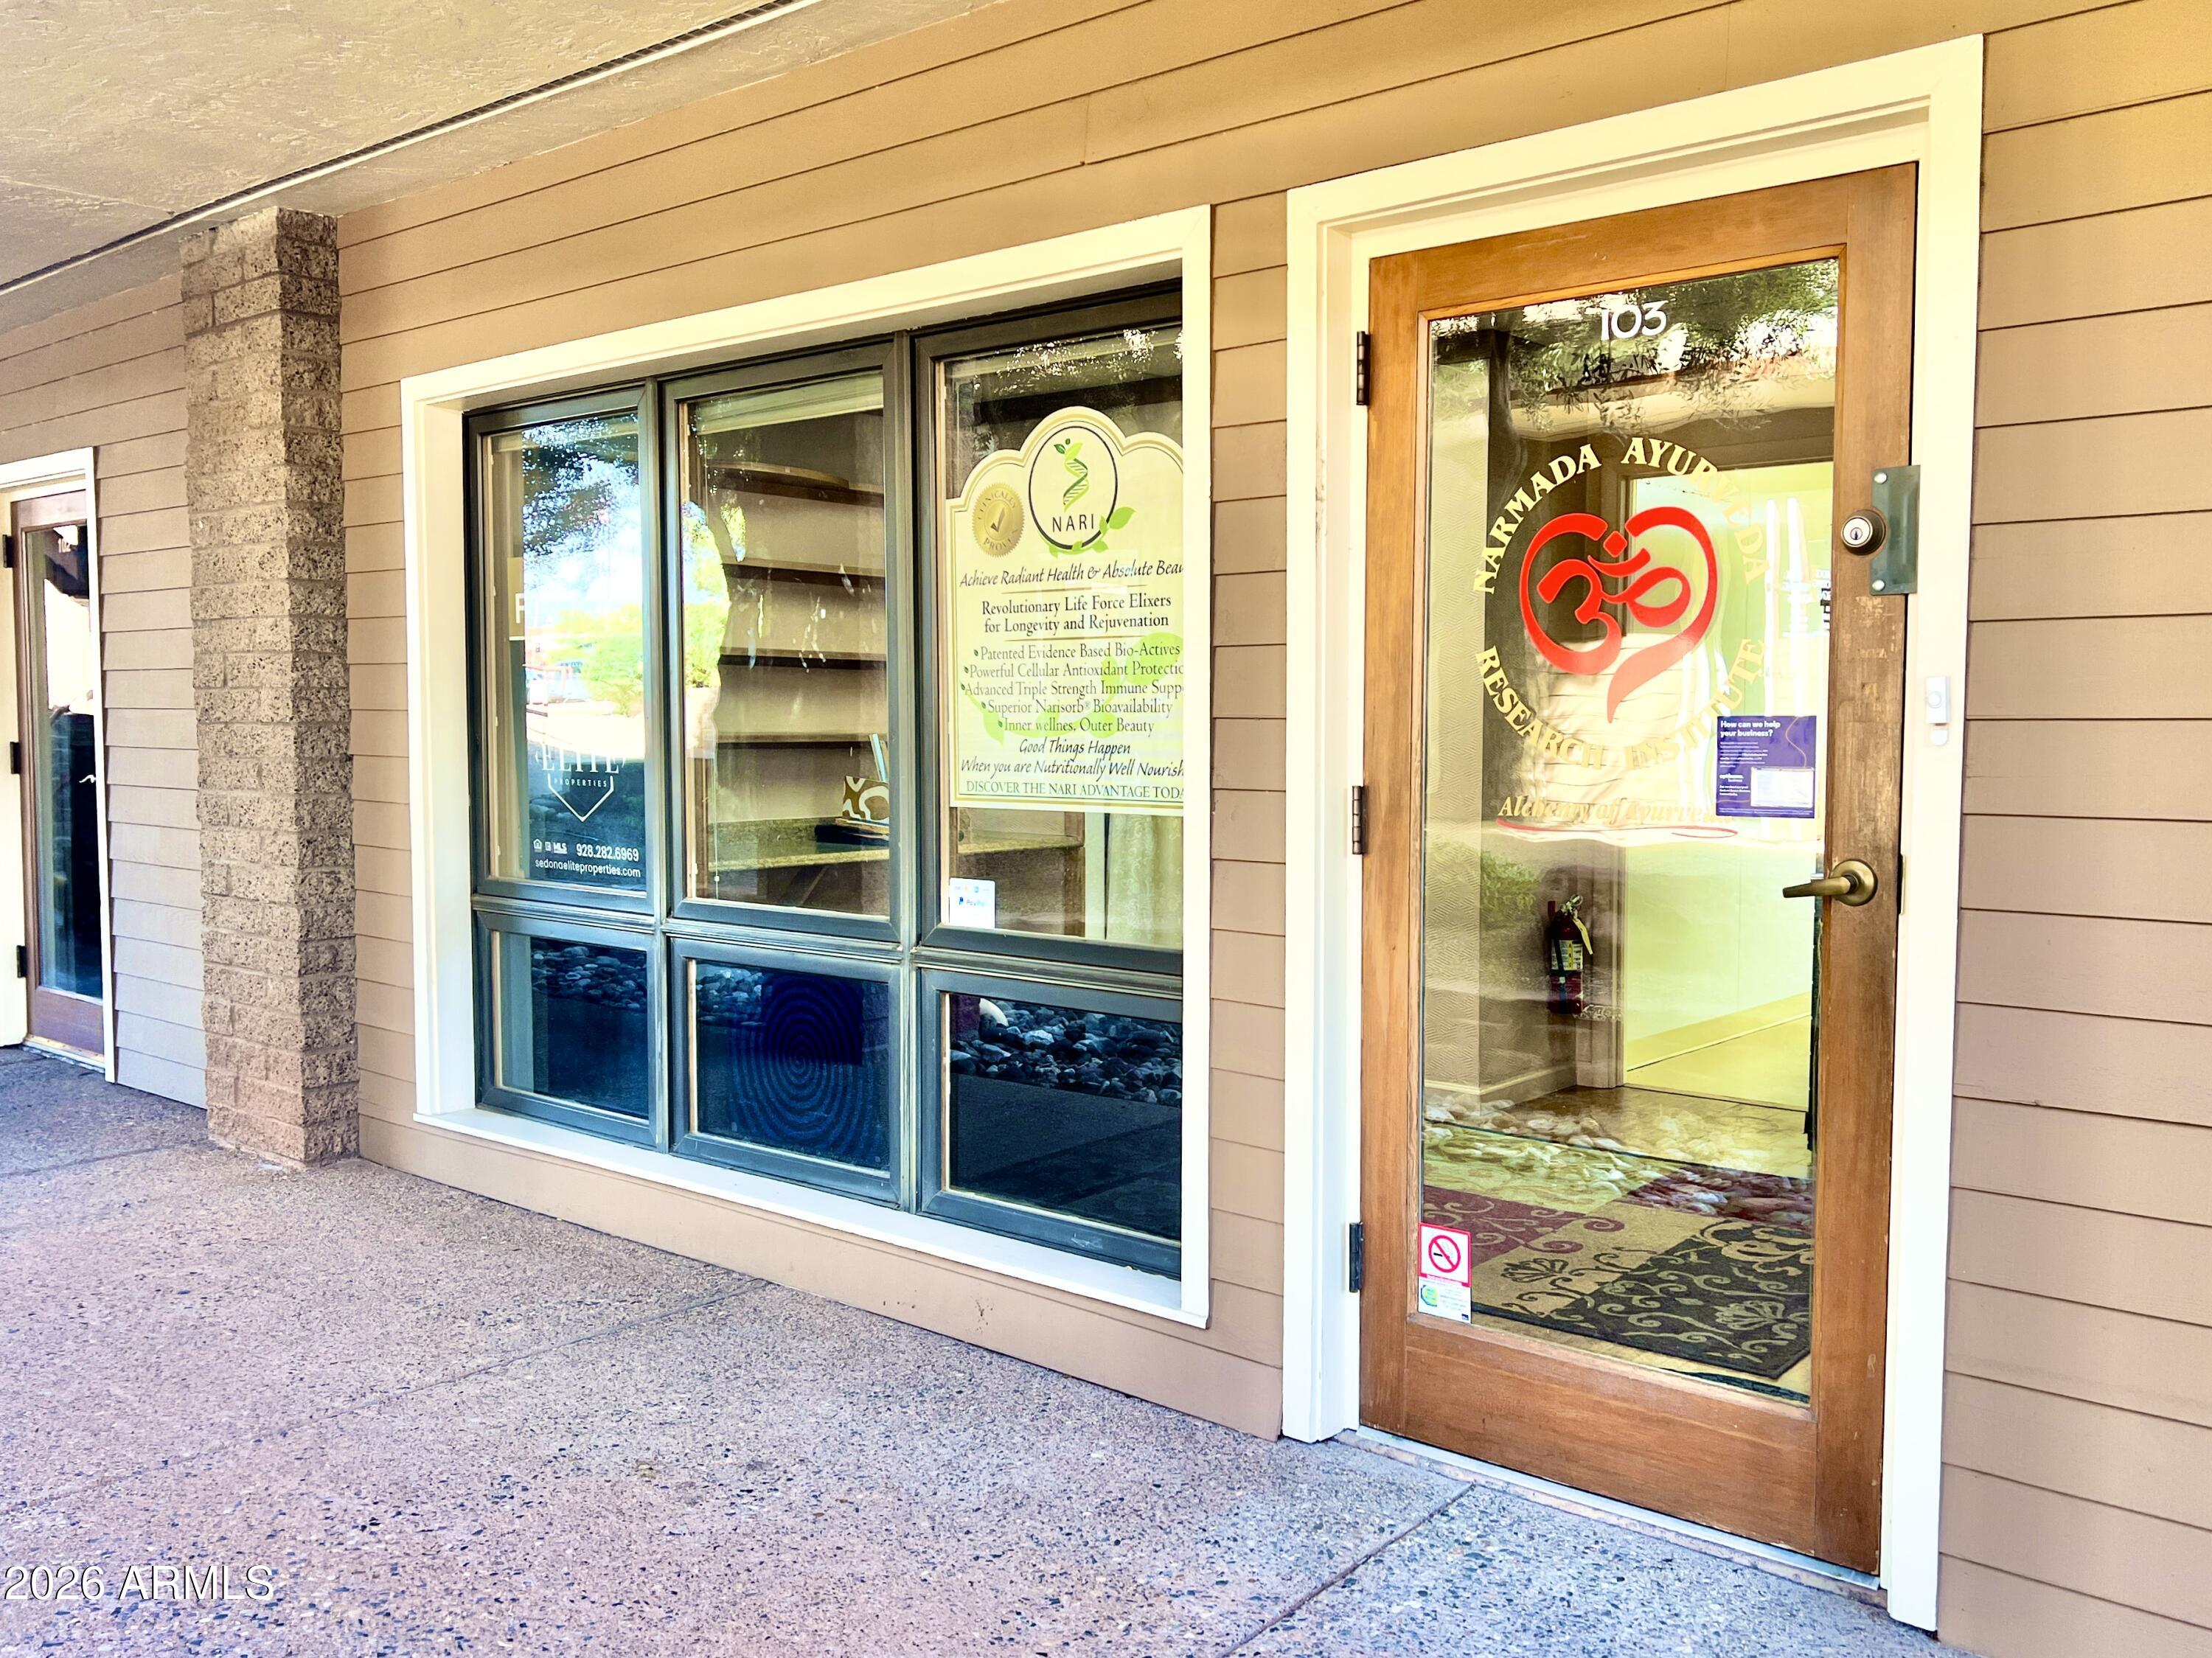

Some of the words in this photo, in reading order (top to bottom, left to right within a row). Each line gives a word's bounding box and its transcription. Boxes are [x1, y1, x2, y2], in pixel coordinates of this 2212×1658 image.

[1601, 300, 1669, 341] 103
[1052, 513, 1094, 532] NARI
[1473, 443, 1602, 595] NARMADA
[1621, 437, 1770, 585] AYURVEDA
[959, 569, 998, 588] Achieve
[1001, 566, 1045, 585] Radiant
[1047, 562, 1084, 582] Health
[1088, 565, 1101, 579] &
[1102, 559, 1153, 579] Absolute
[982, 599, 1060, 617] Revolutionary
[1065, 595, 1088, 611] Life
[1092, 595, 1125, 610] Force
[1130, 593, 1172, 608] Elixers
[985, 618, 1001, 633] for
[1005, 616, 1060, 636] Longevity
[1063, 614, 1085, 630] and
[1090, 612, 1169, 633] Rejuvenation
[981, 645, 1024, 660] Patented
[1029, 644, 1076, 658] Evidence
[1080, 642, 1110, 658] Based
[1115, 641, 1180, 657] Bio-Actives
[970, 663, 1014, 678] Powerful
[1018, 662, 1060, 678] Cellular
[1063, 661, 1128, 676] Antioxidant
[965, 681, 1014, 695] Advanced
[1015, 680, 1048, 700] Triple
[1051, 680, 1096, 700] Strength
[1101, 680, 1148, 694] Immune
[1152, 679, 1183, 699] Supp
[988, 699, 1032, 718] Superior
[1093, 698, 1173, 718] Bioavailability
[1475, 645, 1606, 770] RESEARCH
[1624, 638, 1765, 771] INSTITUTE
[1004, 717, 1032, 731] Inner
[1079, 717, 1113, 732] Outer
[1116, 717, 1155, 737] Beauty
[1720, 730, 1736, 738] your
[1737, 729, 1773, 737] business?
[1764, 720, 1781, 729] help
[1019, 736, 1048, 754] Good
[1049, 736, 1085, 762] Things
[1088, 740, 1130, 761] Happen
[961, 756, 990, 772] When
[990, 762, 1011, 779] you
[1014, 762, 1032, 773] are
[1034, 758, 1106, 782] Nutritionally
[1109, 759, 1135, 775] Well
[554, 778, 608, 787] PROPERTIES
[966, 780, 1022, 793] DISCOVER
[1020, 782, 1046, 794] THE
[1048, 783, 1077, 795] NARI
[1080, 784, 1150, 798] ADVANTAGE
[1625, 799, 1733, 825] Ayurve
[576, 843, 639, 862] 928.282.6969
[535, 858, 641, 878] sedonaeliteproperties.com
